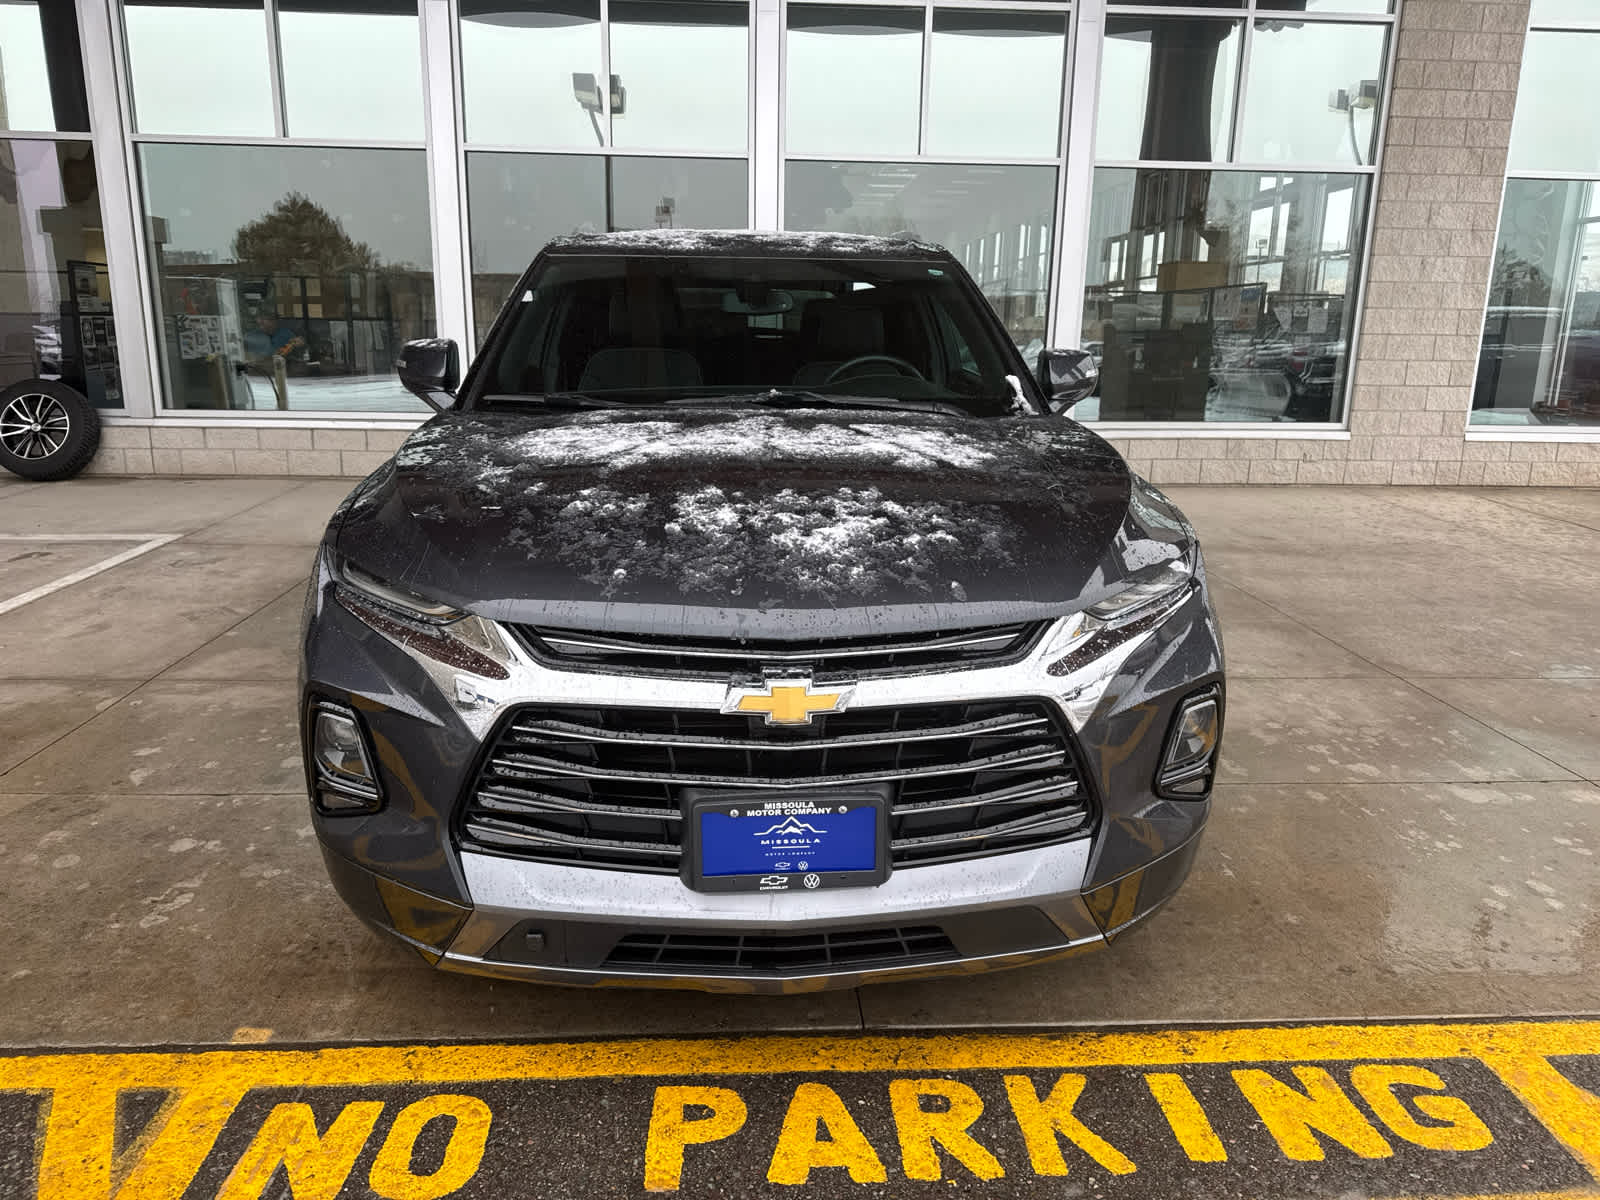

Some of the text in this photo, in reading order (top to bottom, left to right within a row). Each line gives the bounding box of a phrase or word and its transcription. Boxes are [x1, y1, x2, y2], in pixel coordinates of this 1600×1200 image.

[764, 801, 815, 810] MISSOULA
[746, 807, 832, 817] MOTOR COMPANY
[214, 1063, 1495, 1200] NO PARKING
